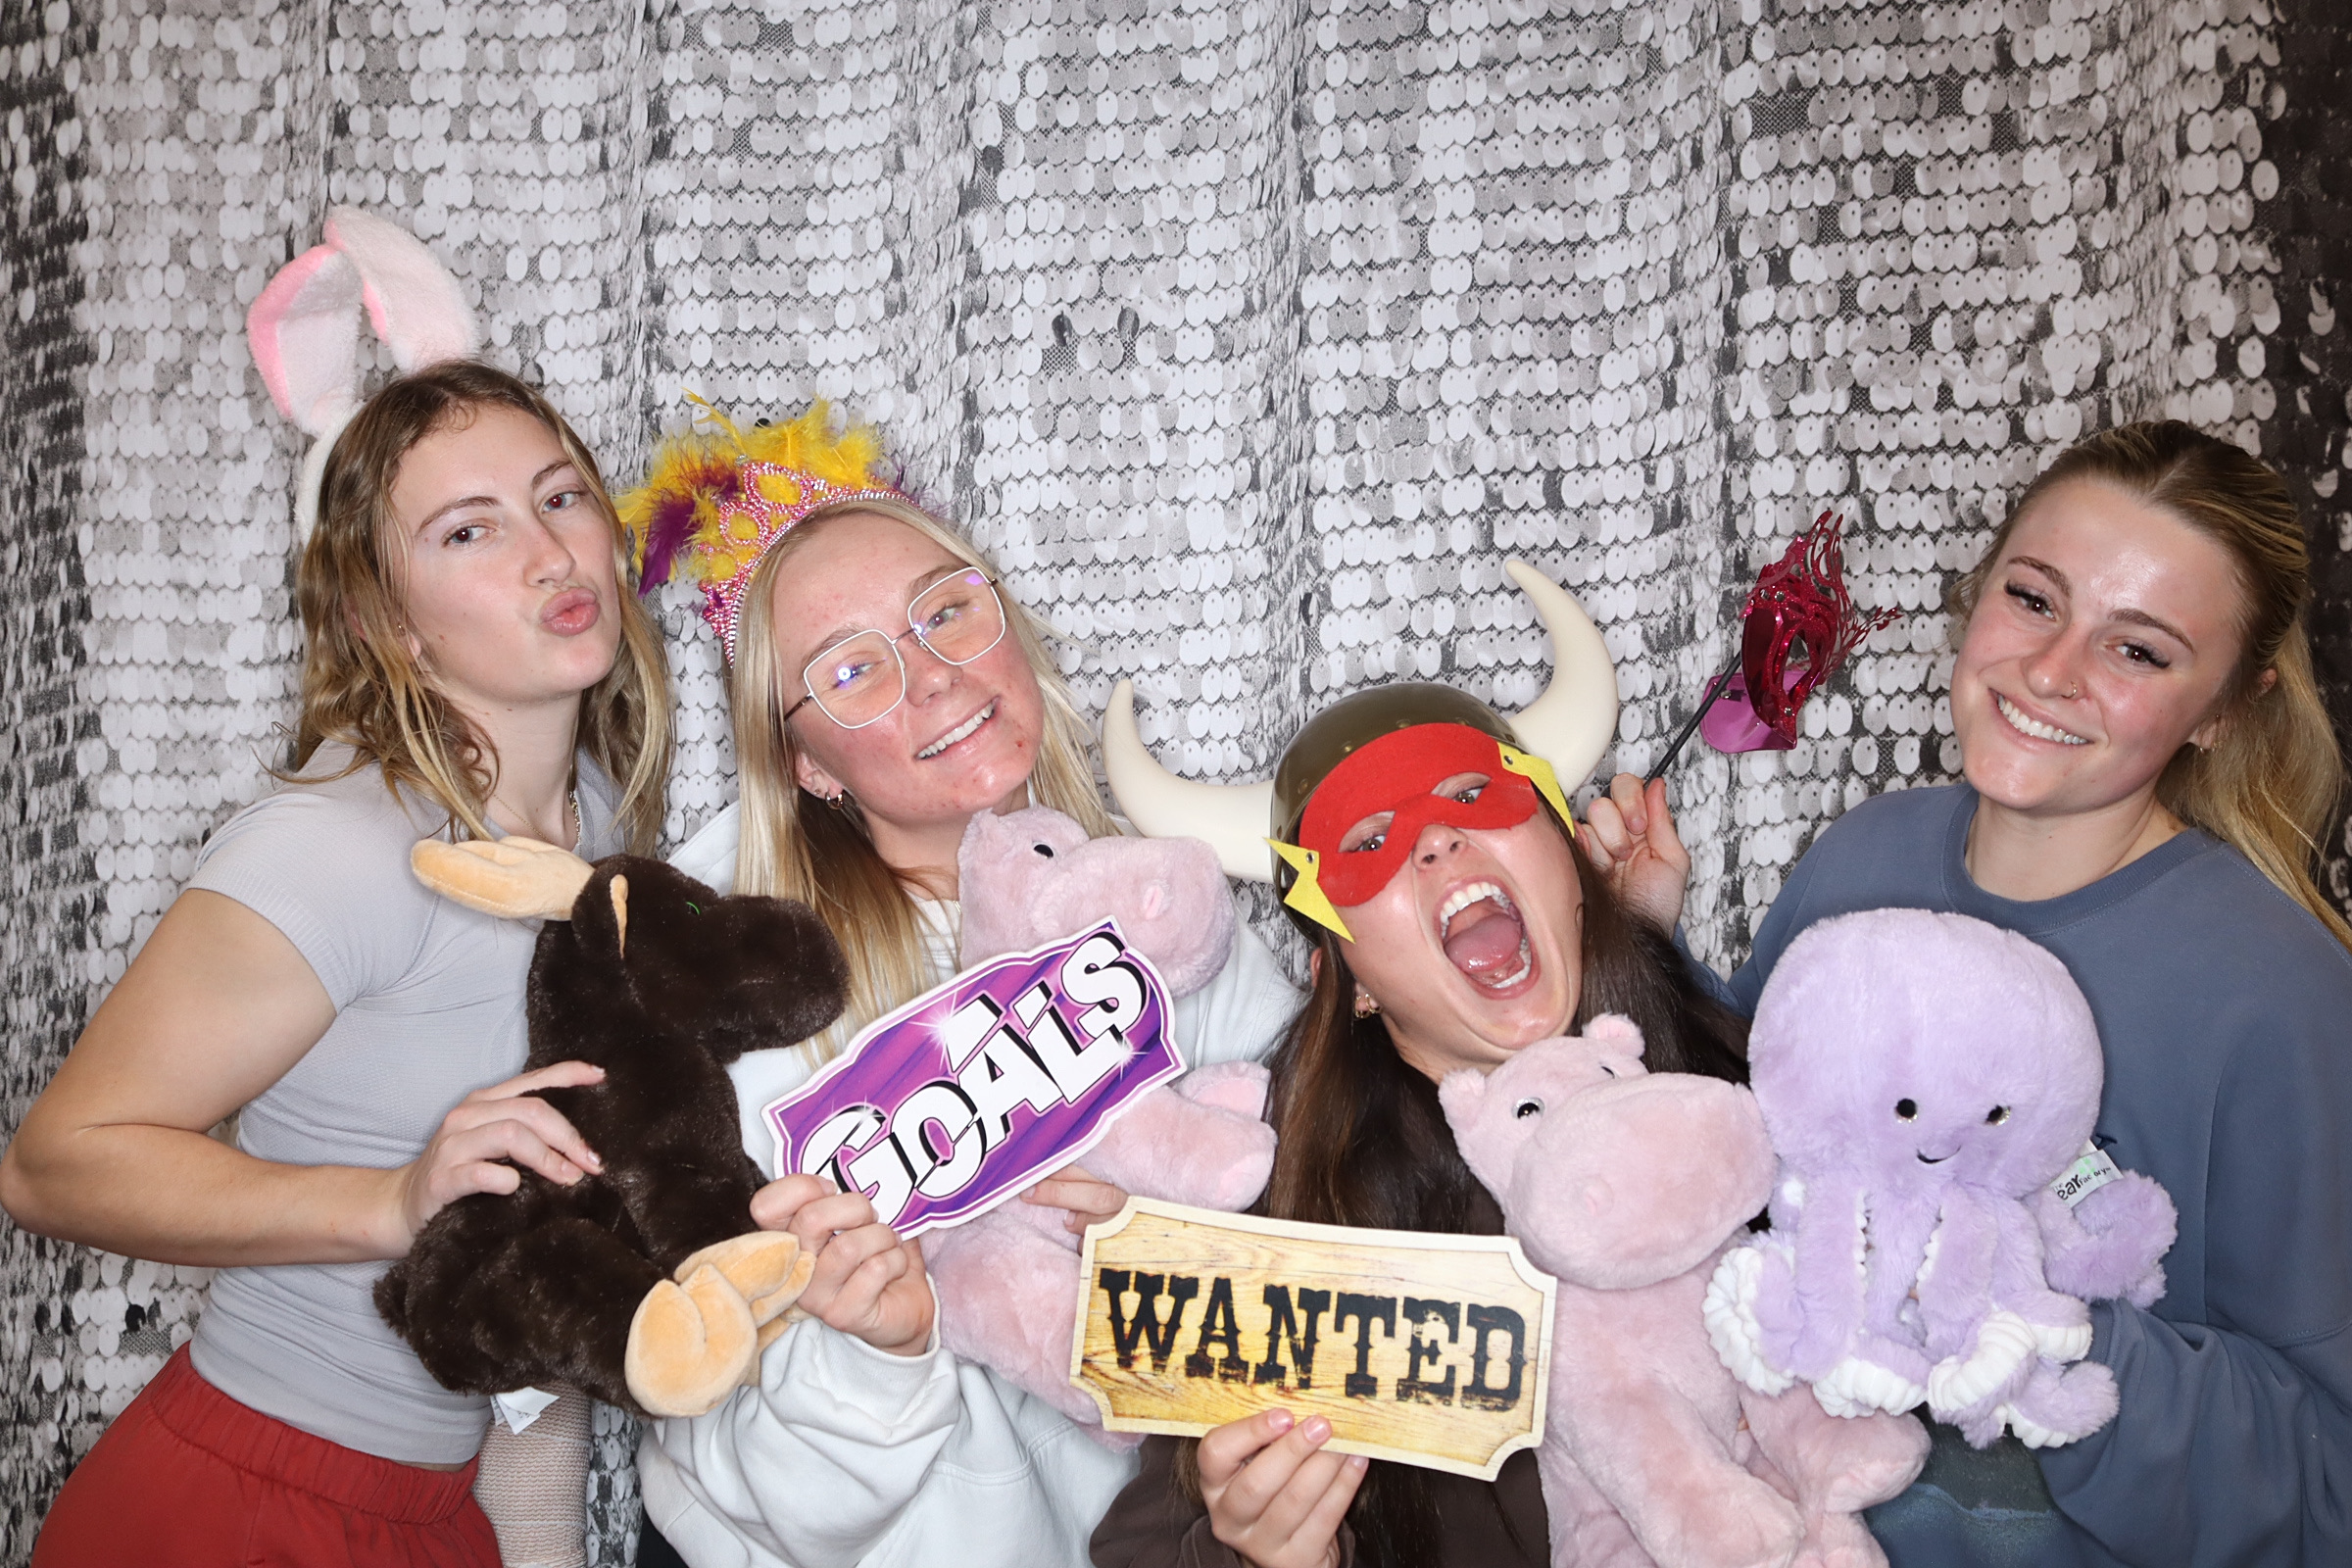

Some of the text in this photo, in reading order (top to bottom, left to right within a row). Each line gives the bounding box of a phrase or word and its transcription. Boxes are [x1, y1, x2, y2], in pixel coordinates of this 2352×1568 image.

[800, 930, 1148, 1225] GOALS
[2056, 1173, 2082, 1200] ear
[1099, 1267, 1528, 1413] WANTED
